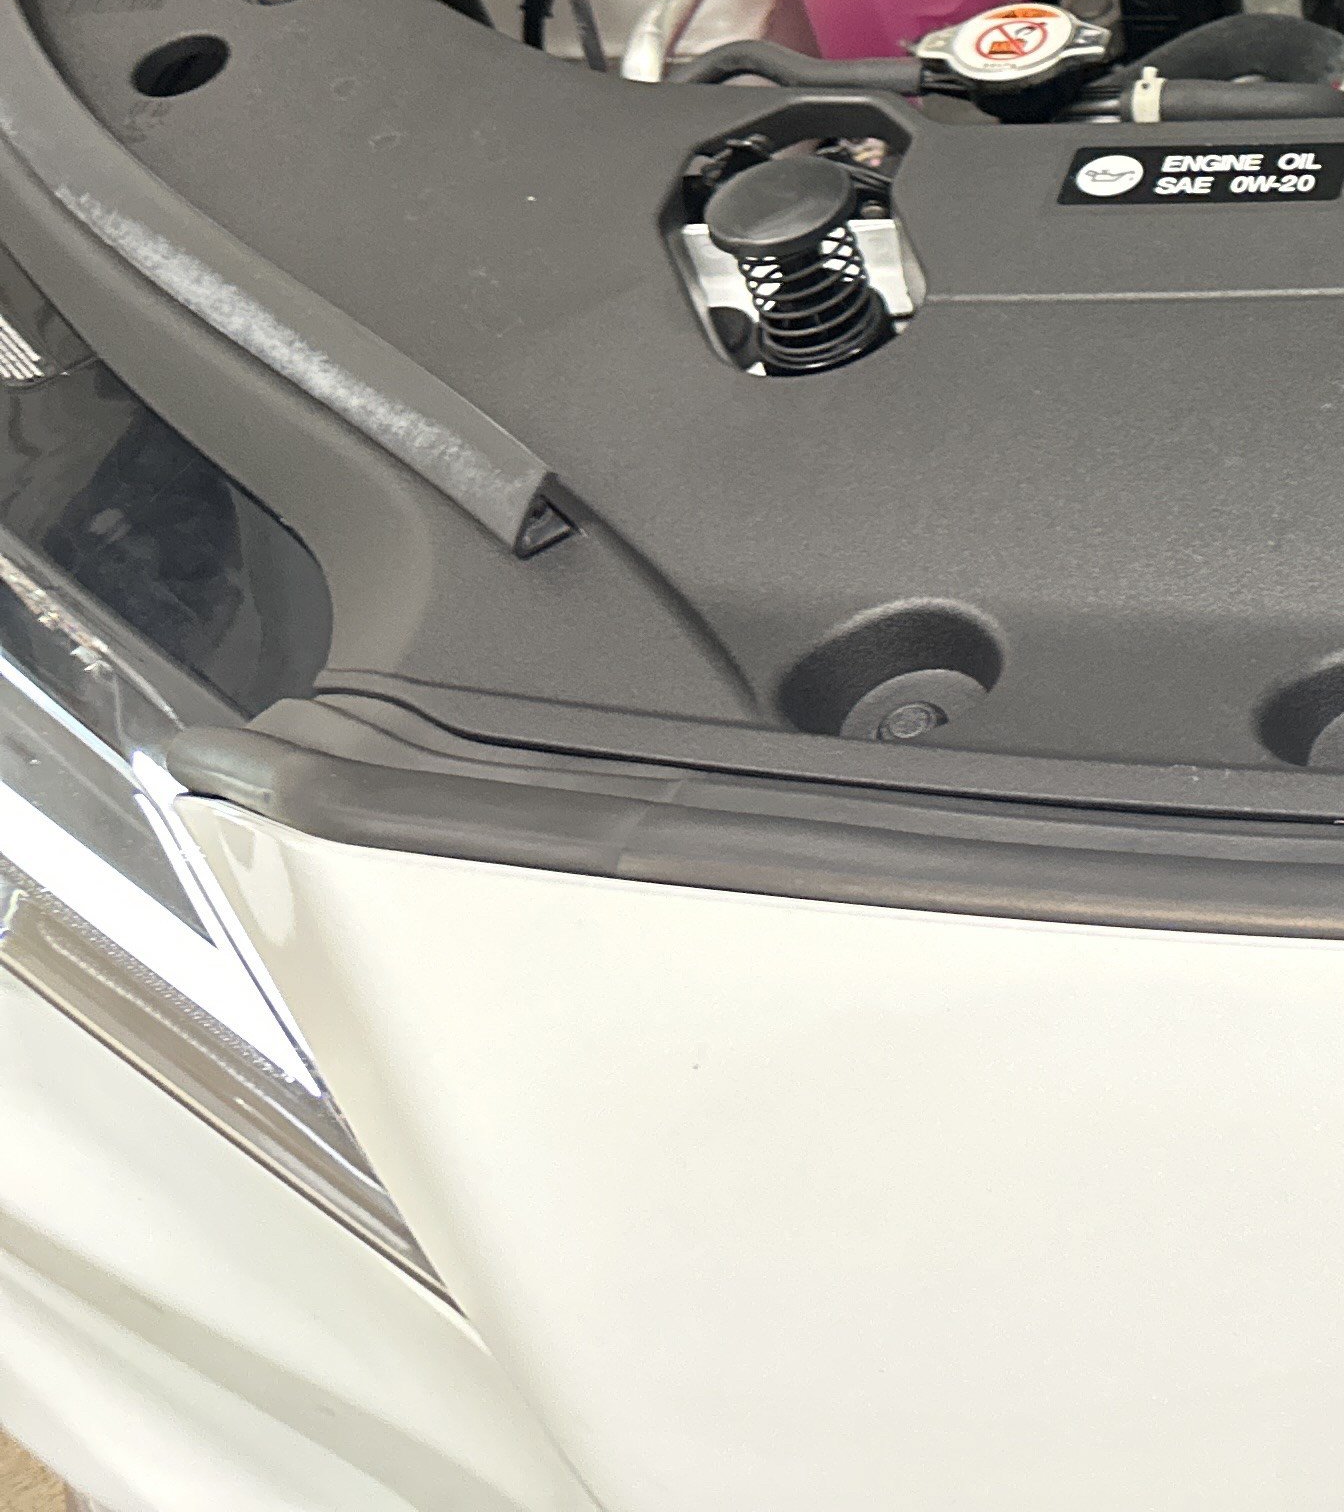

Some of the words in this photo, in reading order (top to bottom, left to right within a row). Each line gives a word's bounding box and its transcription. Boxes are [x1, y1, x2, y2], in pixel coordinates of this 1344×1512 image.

[1161, 153, 1264, 173] ENGINE
[1277, 152, 1322, 170] OIL
[1154, 176, 1215, 195] SAE
[1229, 174, 1316, 193] 0W-20
